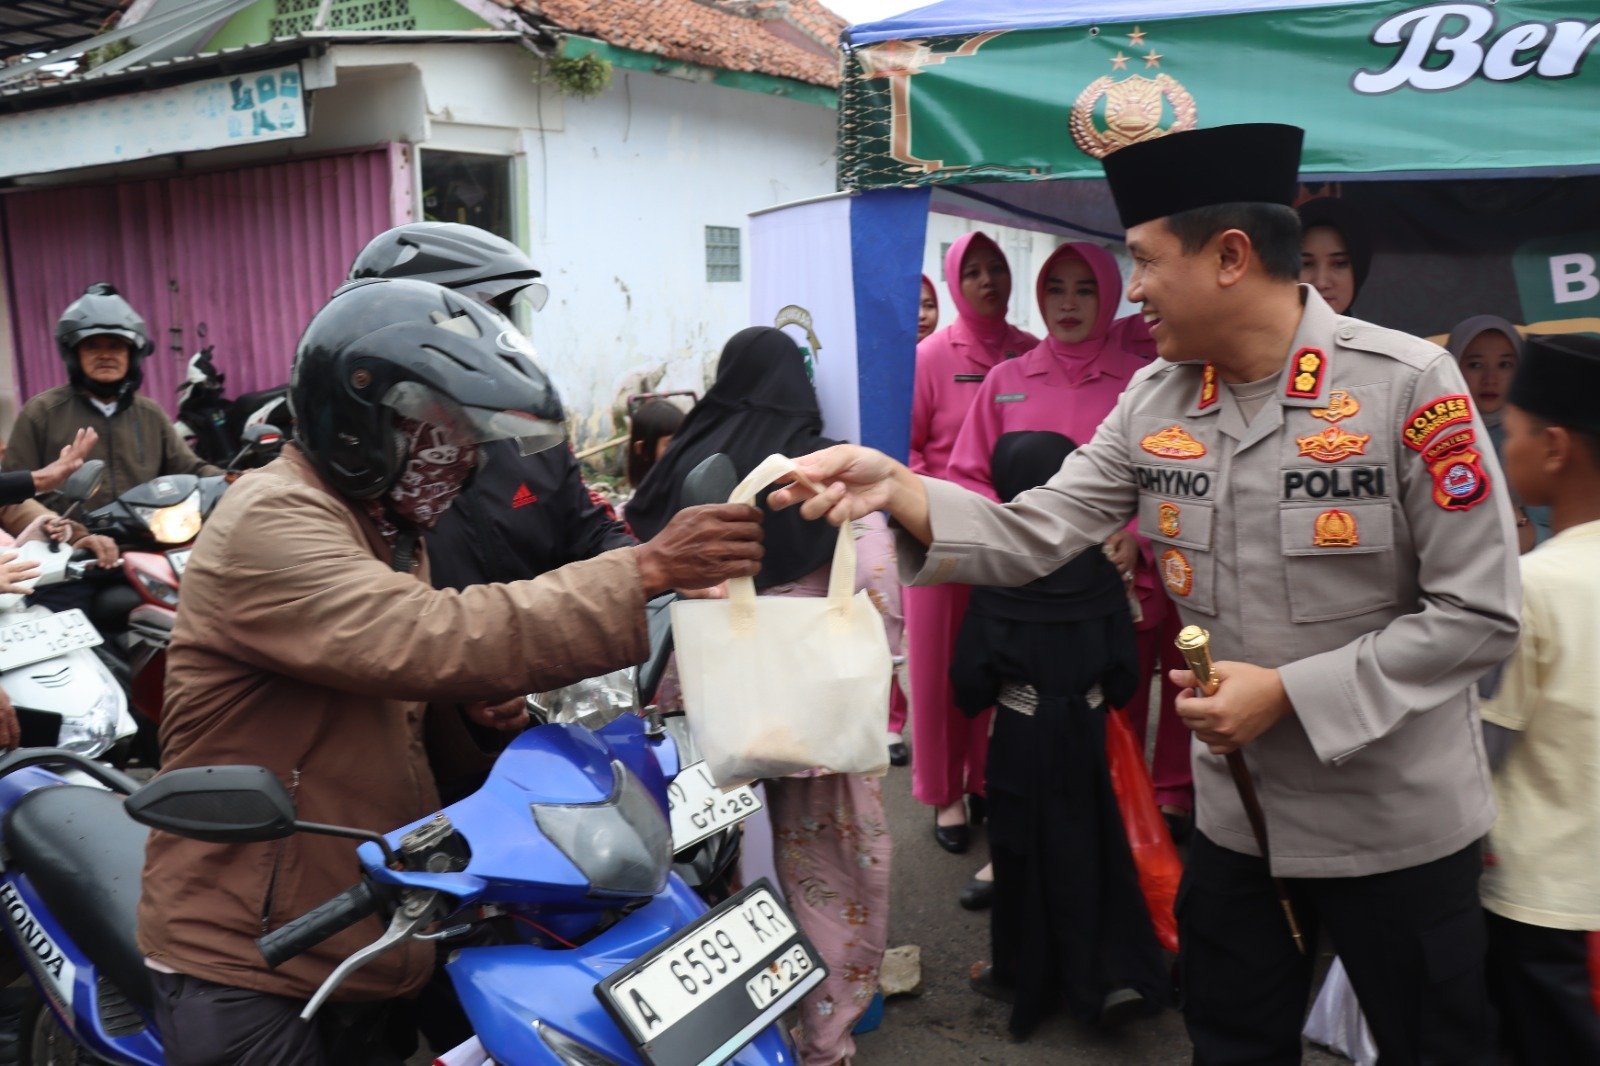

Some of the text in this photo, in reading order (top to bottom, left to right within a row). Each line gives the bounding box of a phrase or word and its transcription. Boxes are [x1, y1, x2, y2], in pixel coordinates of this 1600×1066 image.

[1549, 253, 1600, 304] B
[1405, 399, 1467, 440] POLRES
[1284, 468, 1386, 498] POLRI
[0, 884, 65, 979] HONDA
[628, 899, 787, 1030] A 6599 KR
